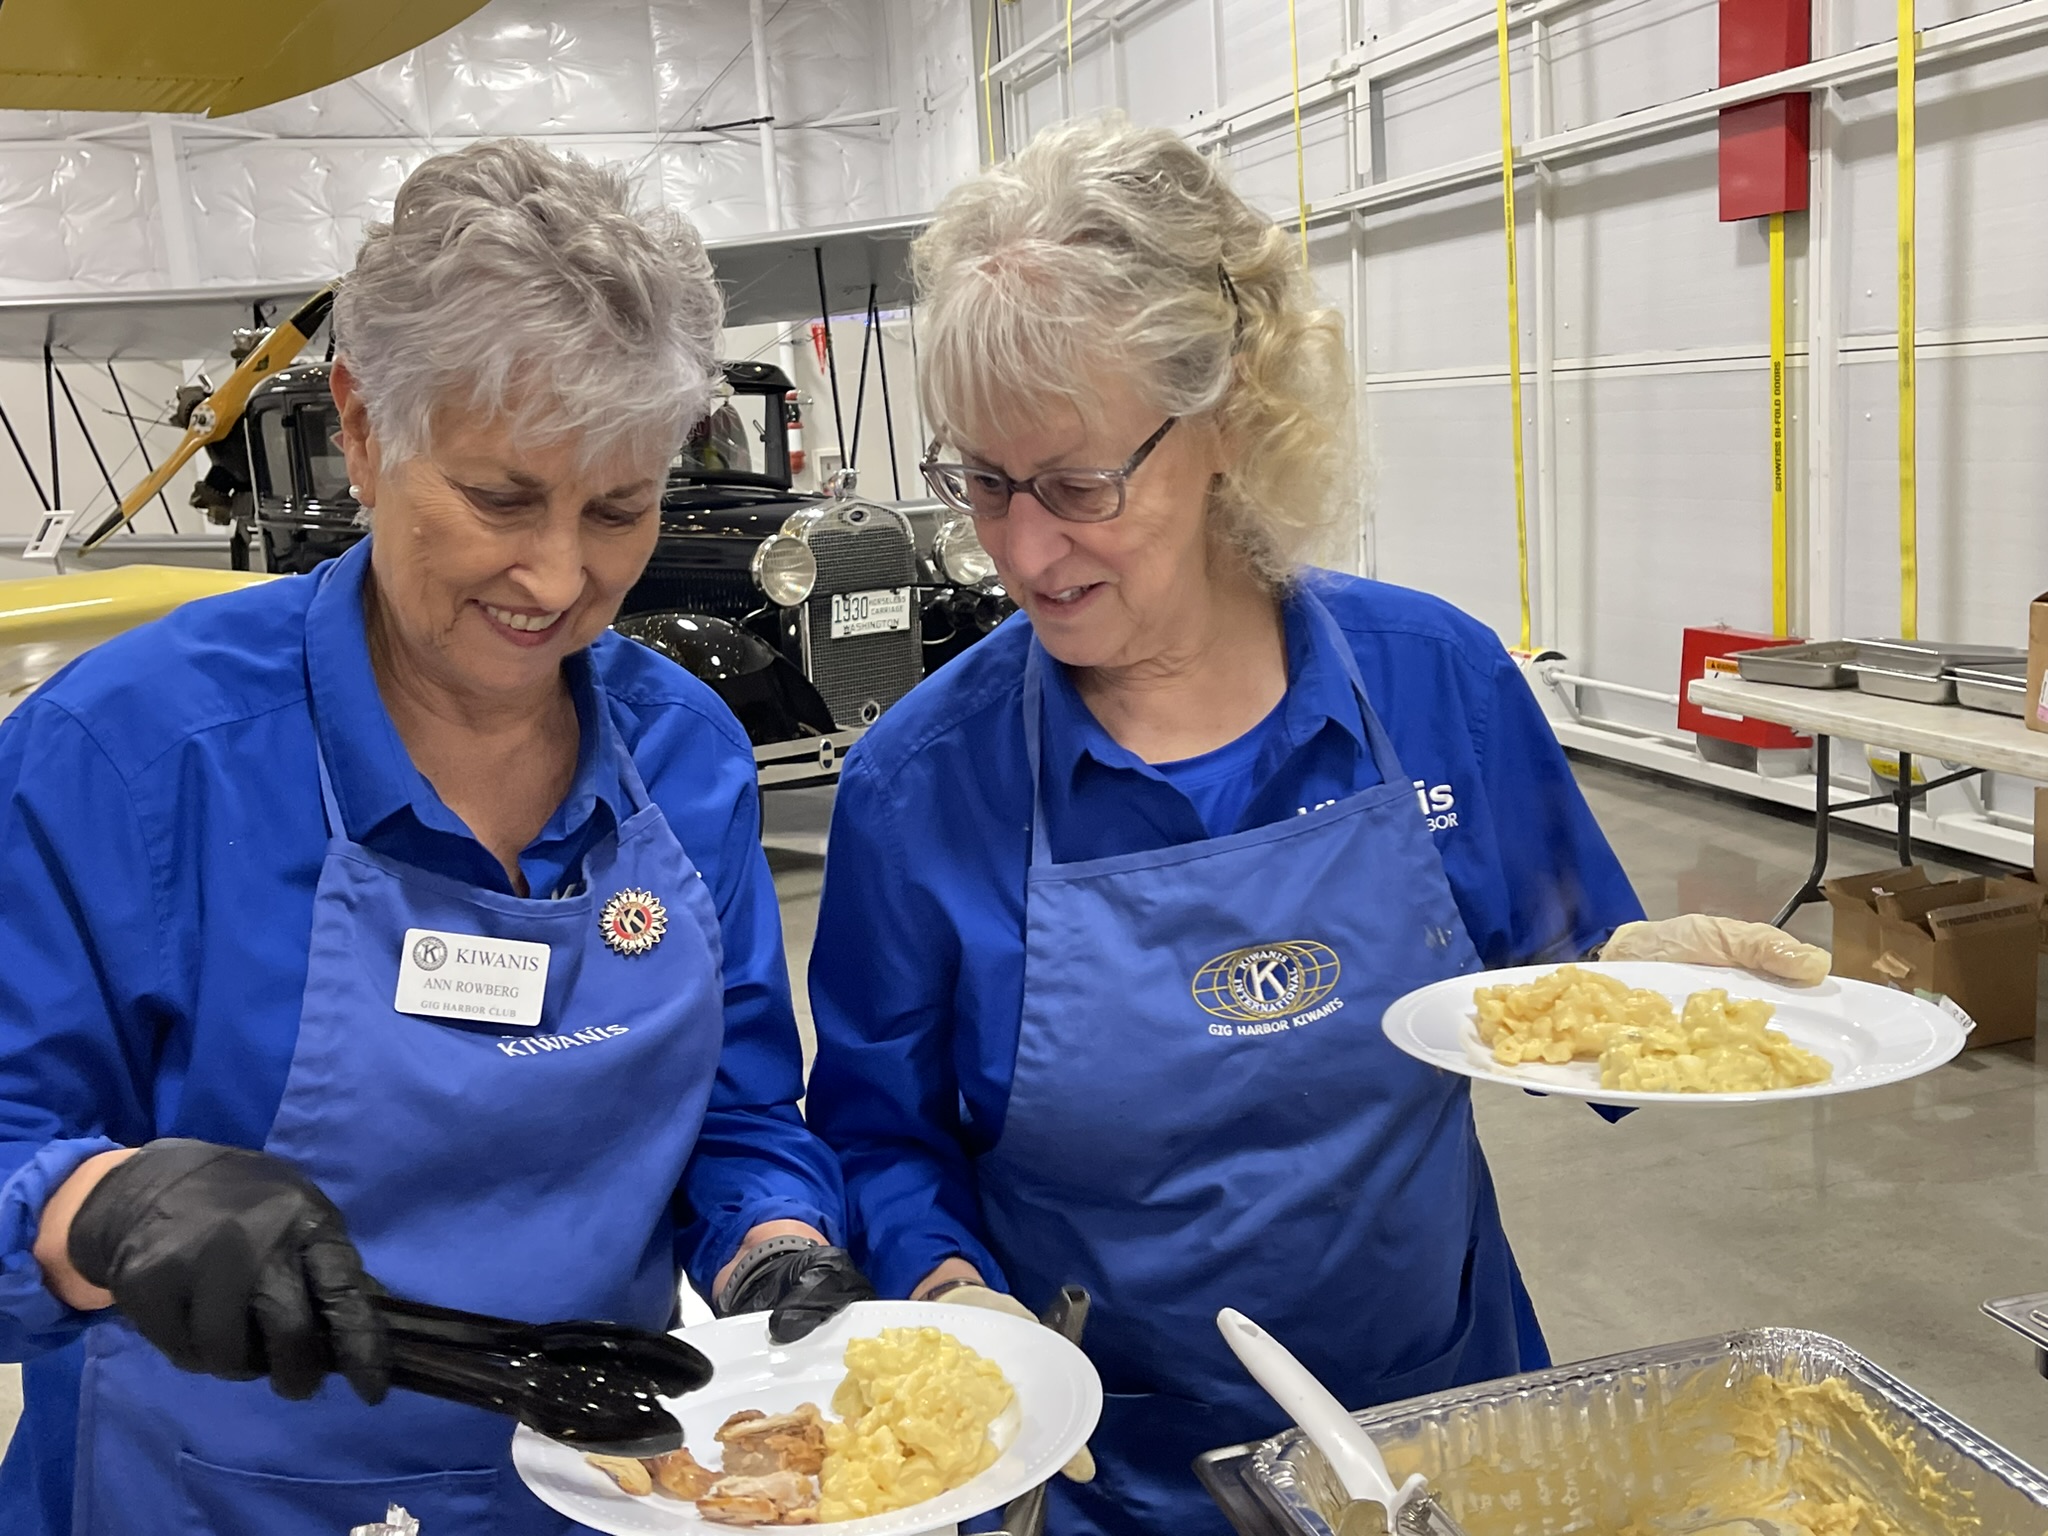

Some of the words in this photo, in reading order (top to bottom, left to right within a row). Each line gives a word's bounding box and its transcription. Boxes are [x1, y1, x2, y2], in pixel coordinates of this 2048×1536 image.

[1773, 361, 1782, 395] DOORS
[1774, 399, 1782, 438] BI-FOLD
[1774, 440, 1783, 492] SCHWEISS
[834, 596, 868, 624] 1930
[871, 605, 904, 616] CARRIAGE
[842, 618, 900, 634] WASHINGTON
[1427, 812, 1459, 832] BOR
[455, 947, 540, 972] KIWANIS
[1238, 950, 1289, 970] KIWANIS
[423, 978, 453, 991] ANN
[455, 981, 520, 999] ROWBERG
[1234, 967, 1299, 1012] INTERNATIONAL
[420, 1000, 440, 1010] GIG
[442, 1002, 486, 1015] HARBOR
[488, 1007, 517, 1018] CLUB
[1208, 1023, 1233, 1036] GIG
[1237, 1020, 1290, 1036] HARBOR
[1292, 997, 1345, 1027] KIWANIS
[496, 1023, 630, 1057] KIWANIS
